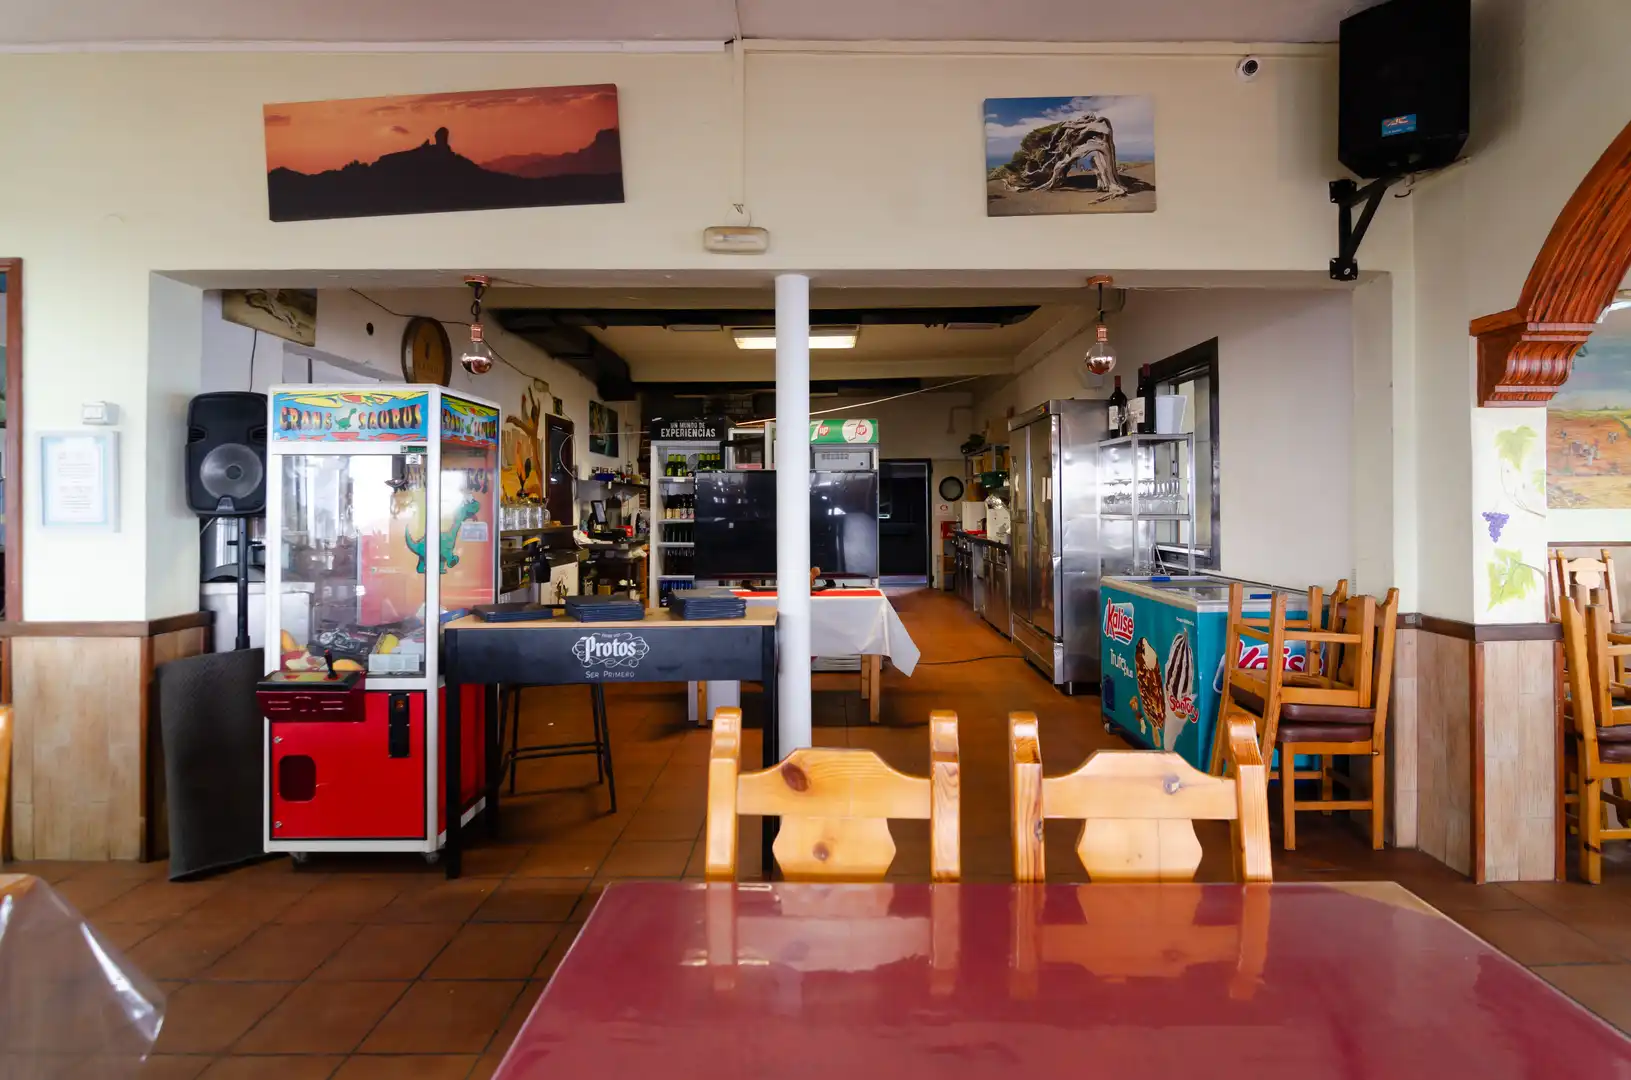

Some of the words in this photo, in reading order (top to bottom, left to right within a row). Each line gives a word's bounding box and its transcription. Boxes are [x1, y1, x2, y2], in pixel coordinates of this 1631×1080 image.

[358, 404, 421, 430] SAURUS
[661, 428, 716, 438] EXPERIENCIAS
[1105, 597, 1134, 641] Kalise
[580, 635, 637, 662] Protos
[585, 670, 600, 679] SER
[603, 670, 635, 678] PRIMERO
